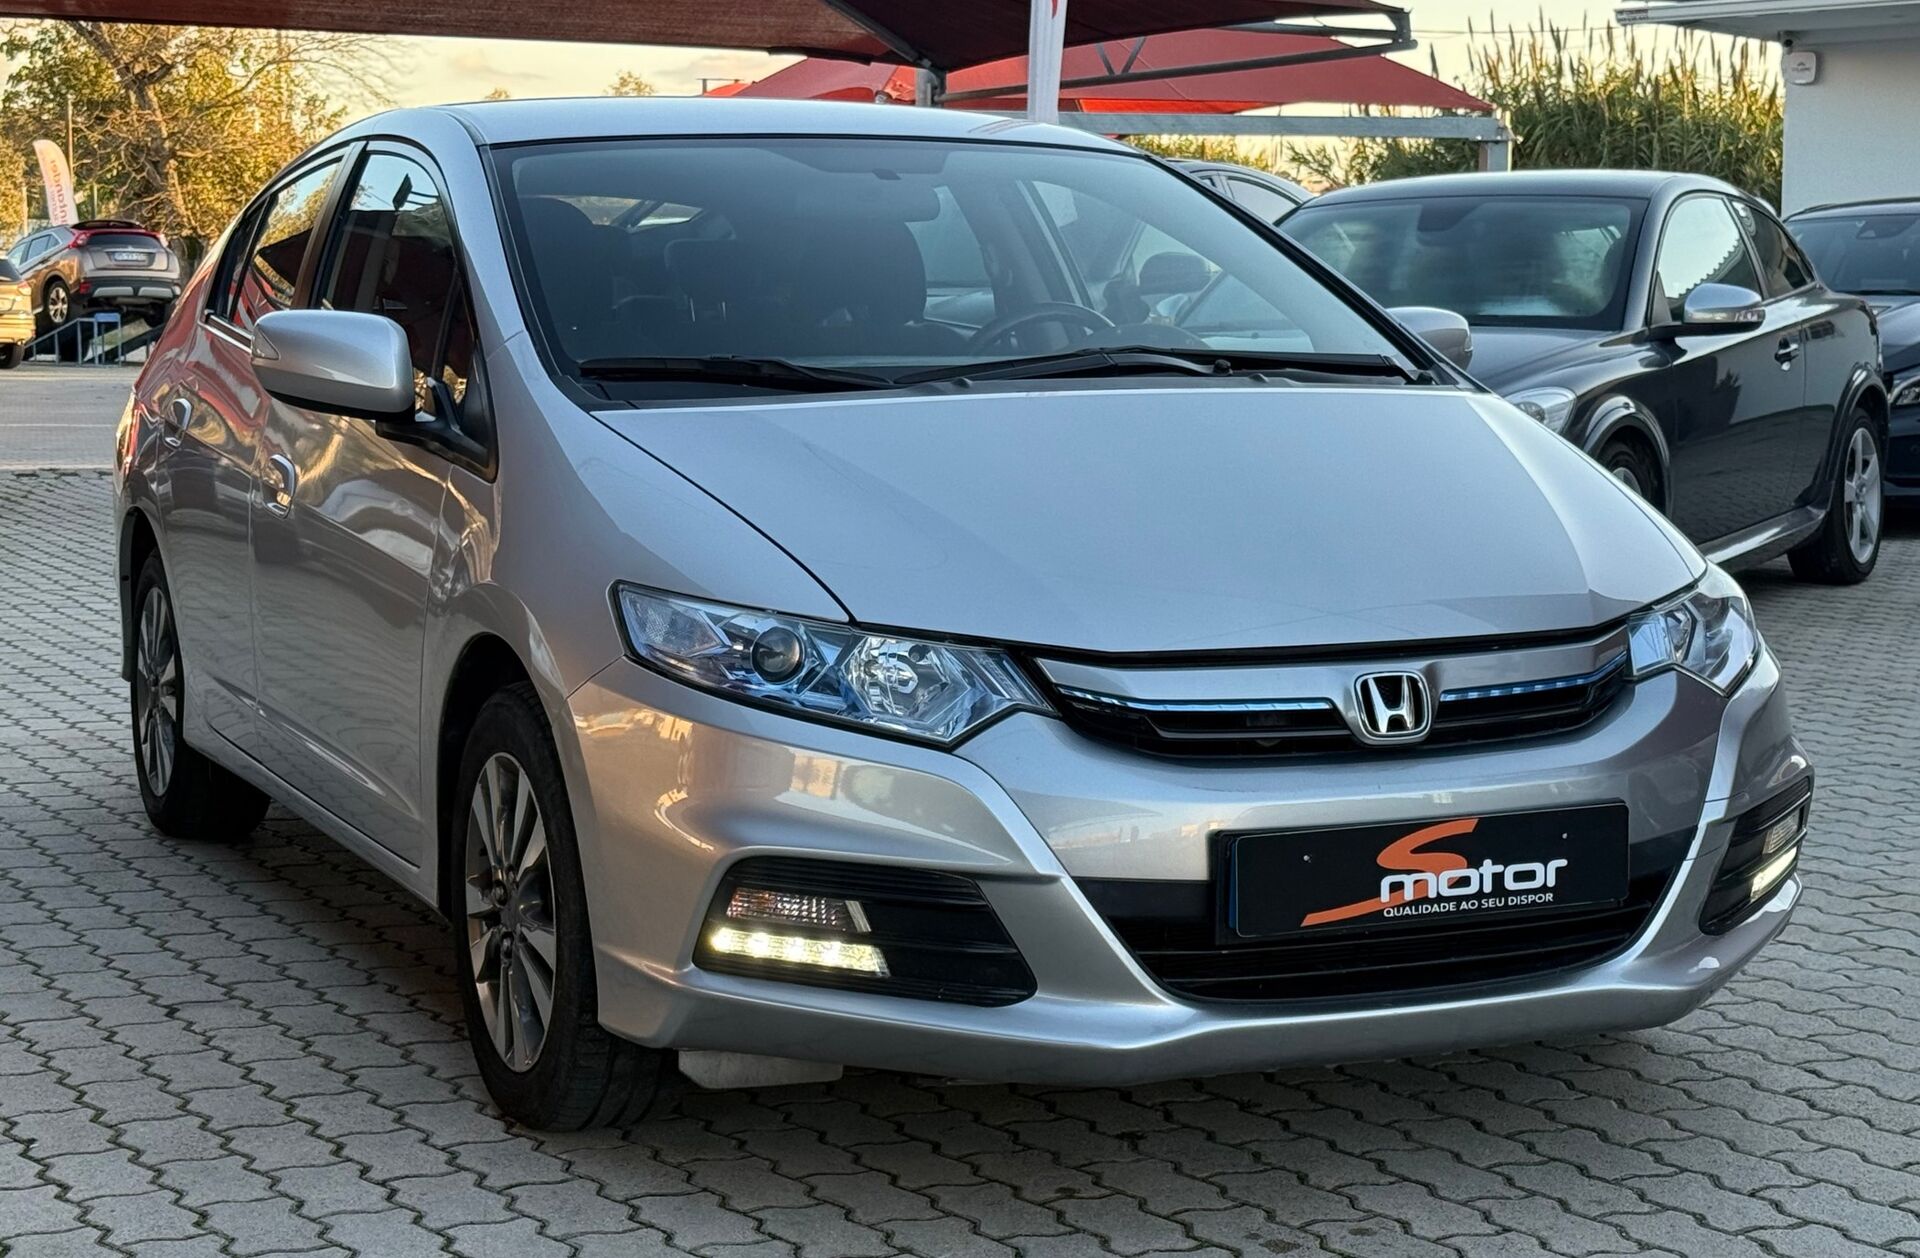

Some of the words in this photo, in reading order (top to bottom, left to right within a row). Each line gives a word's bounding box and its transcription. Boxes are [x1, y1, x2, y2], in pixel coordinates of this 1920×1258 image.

[1380, 858, 1568, 903] motor
[1383, 902, 1457, 918] QUALIDADE
[1459, 899, 1479, 910] AO
[1481, 896, 1505, 909] SEU
[1508, 893, 1554, 907] DISPOR
